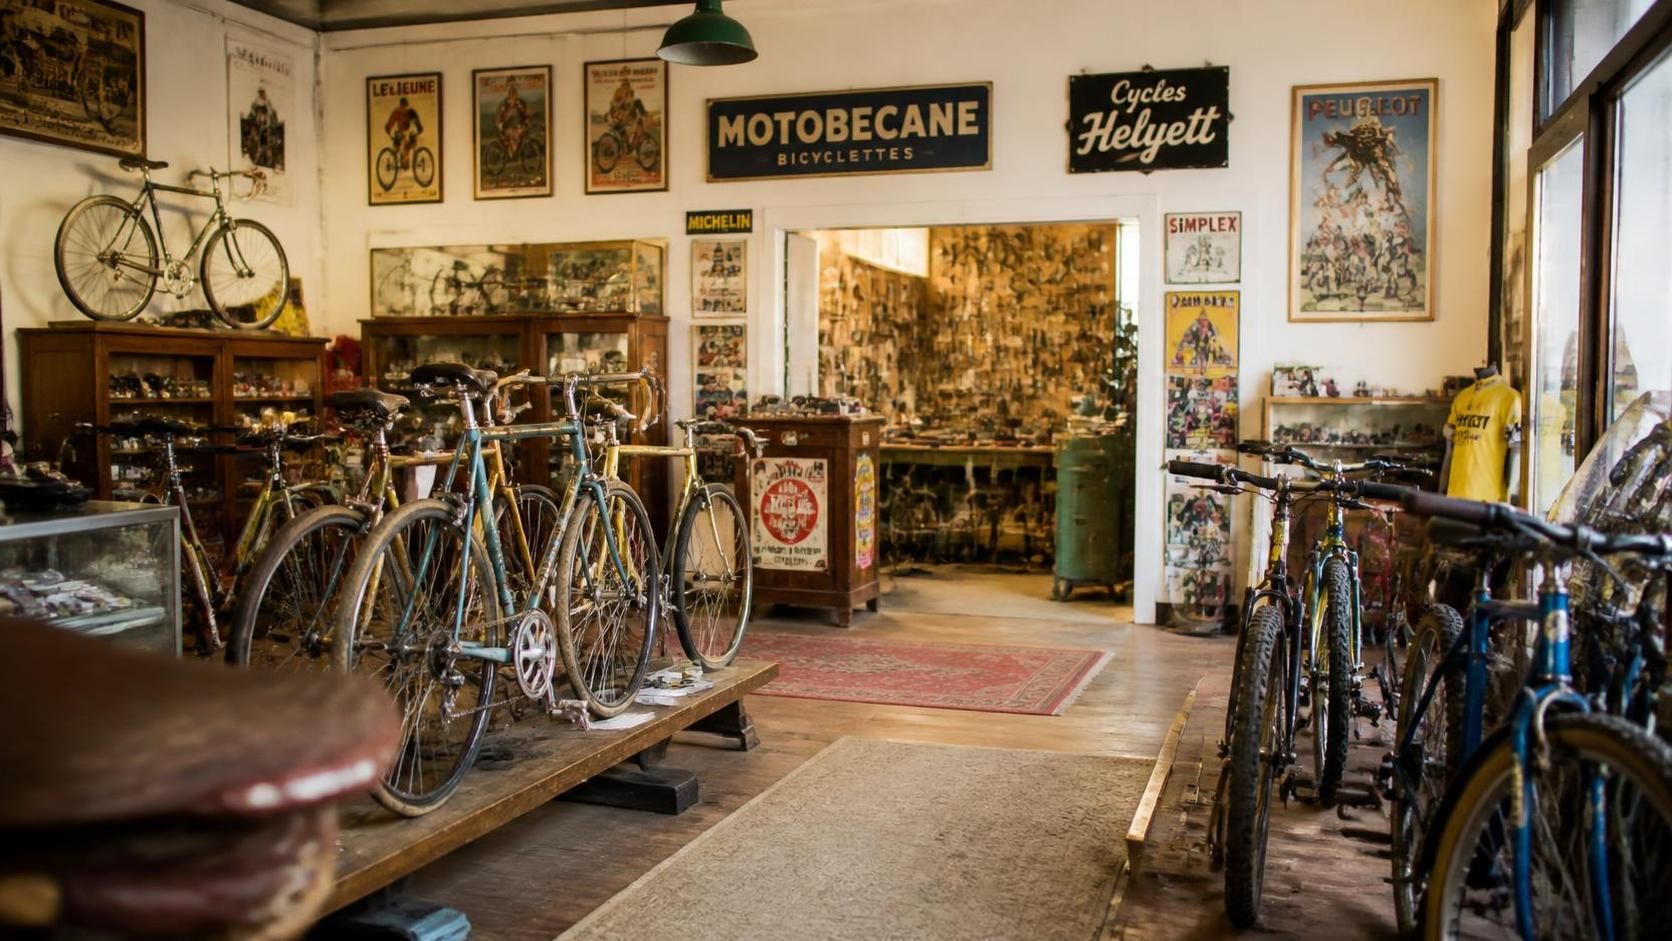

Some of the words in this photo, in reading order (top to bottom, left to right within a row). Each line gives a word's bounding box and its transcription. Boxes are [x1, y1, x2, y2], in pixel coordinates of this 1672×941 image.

[1111, 79, 1187, 114] Cycles
[718, 101, 980, 148] MOTOBECANE
[1076, 105, 1221, 164] Helyett
[777, 147, 914, 166] BICYCLETTES
[688, 213, 751, 230] MICHELIN
